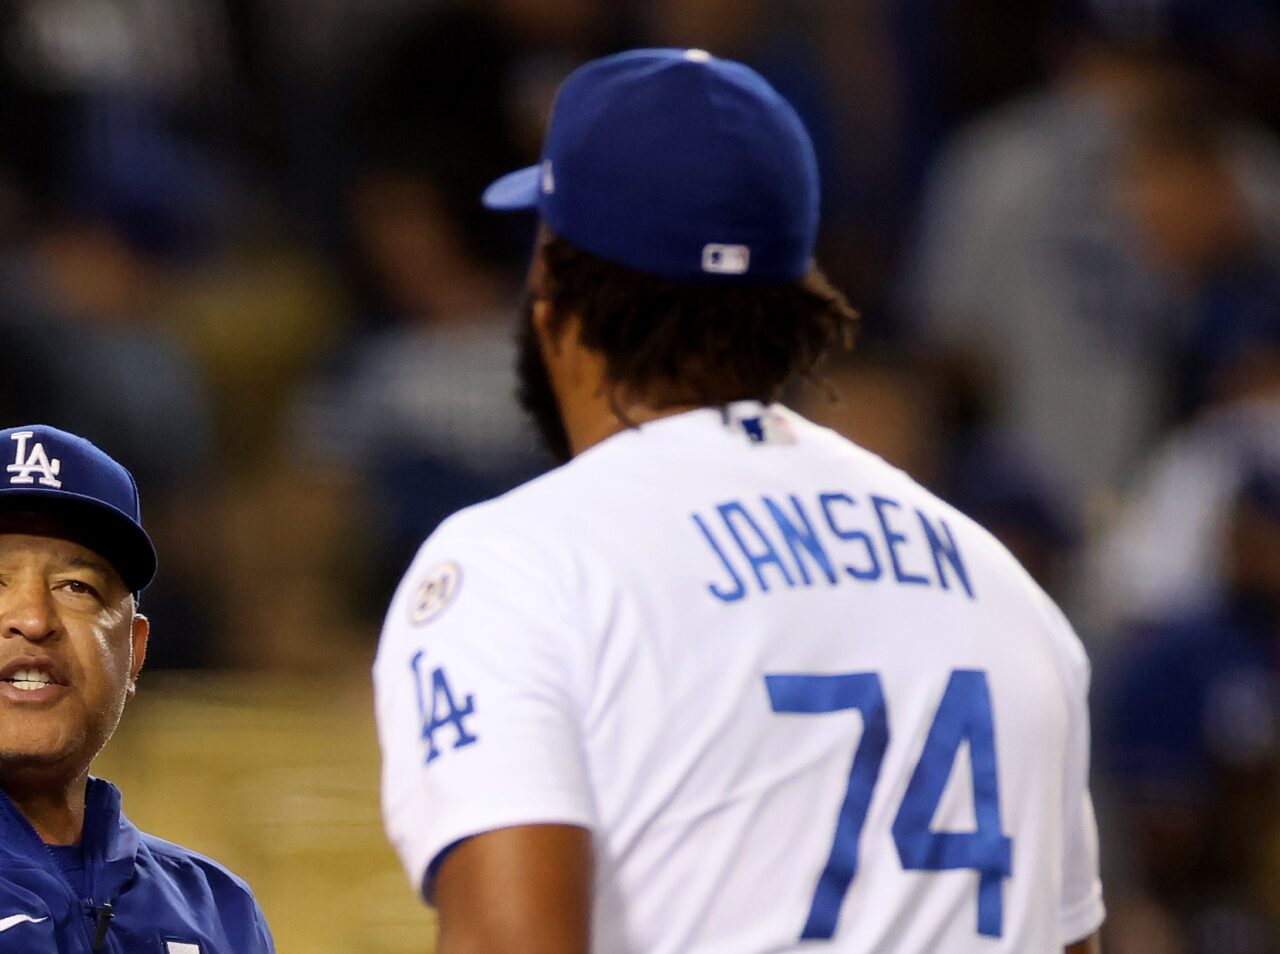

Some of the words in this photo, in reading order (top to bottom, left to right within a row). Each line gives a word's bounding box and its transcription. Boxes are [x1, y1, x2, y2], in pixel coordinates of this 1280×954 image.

[7, 431, 61, 488] LA
[691, 492, 976, 602] JANSEN
[410, 649, 479, 764] LA
[764, 669, 1014, 941] 74
